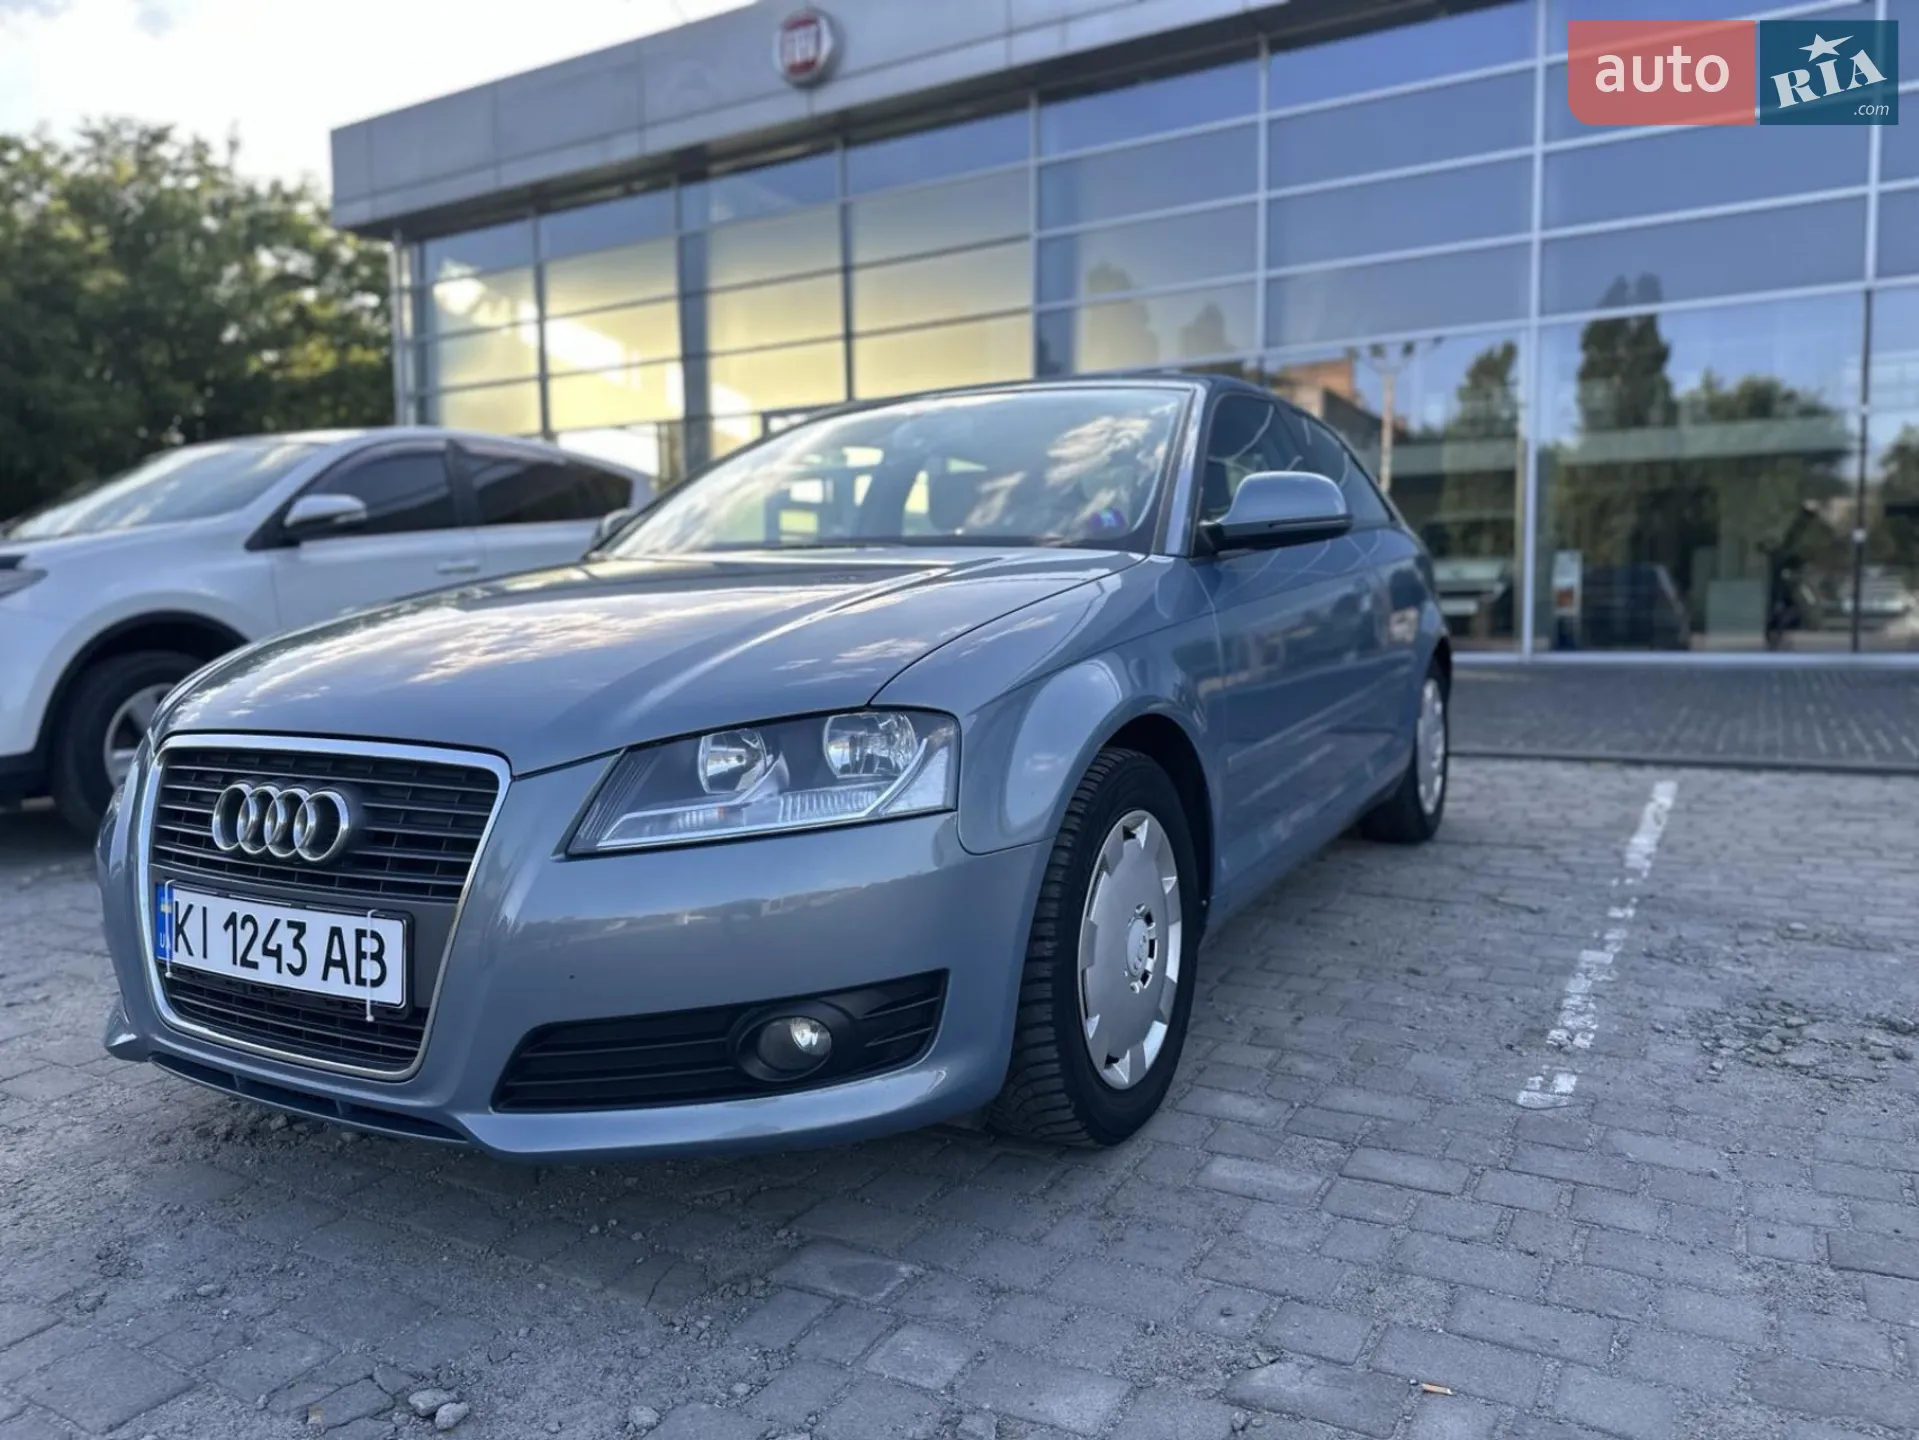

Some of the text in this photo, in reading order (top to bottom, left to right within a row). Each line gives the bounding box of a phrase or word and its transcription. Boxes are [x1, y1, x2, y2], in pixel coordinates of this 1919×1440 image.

[174, 900, 388, 989] KI 1243 AB
